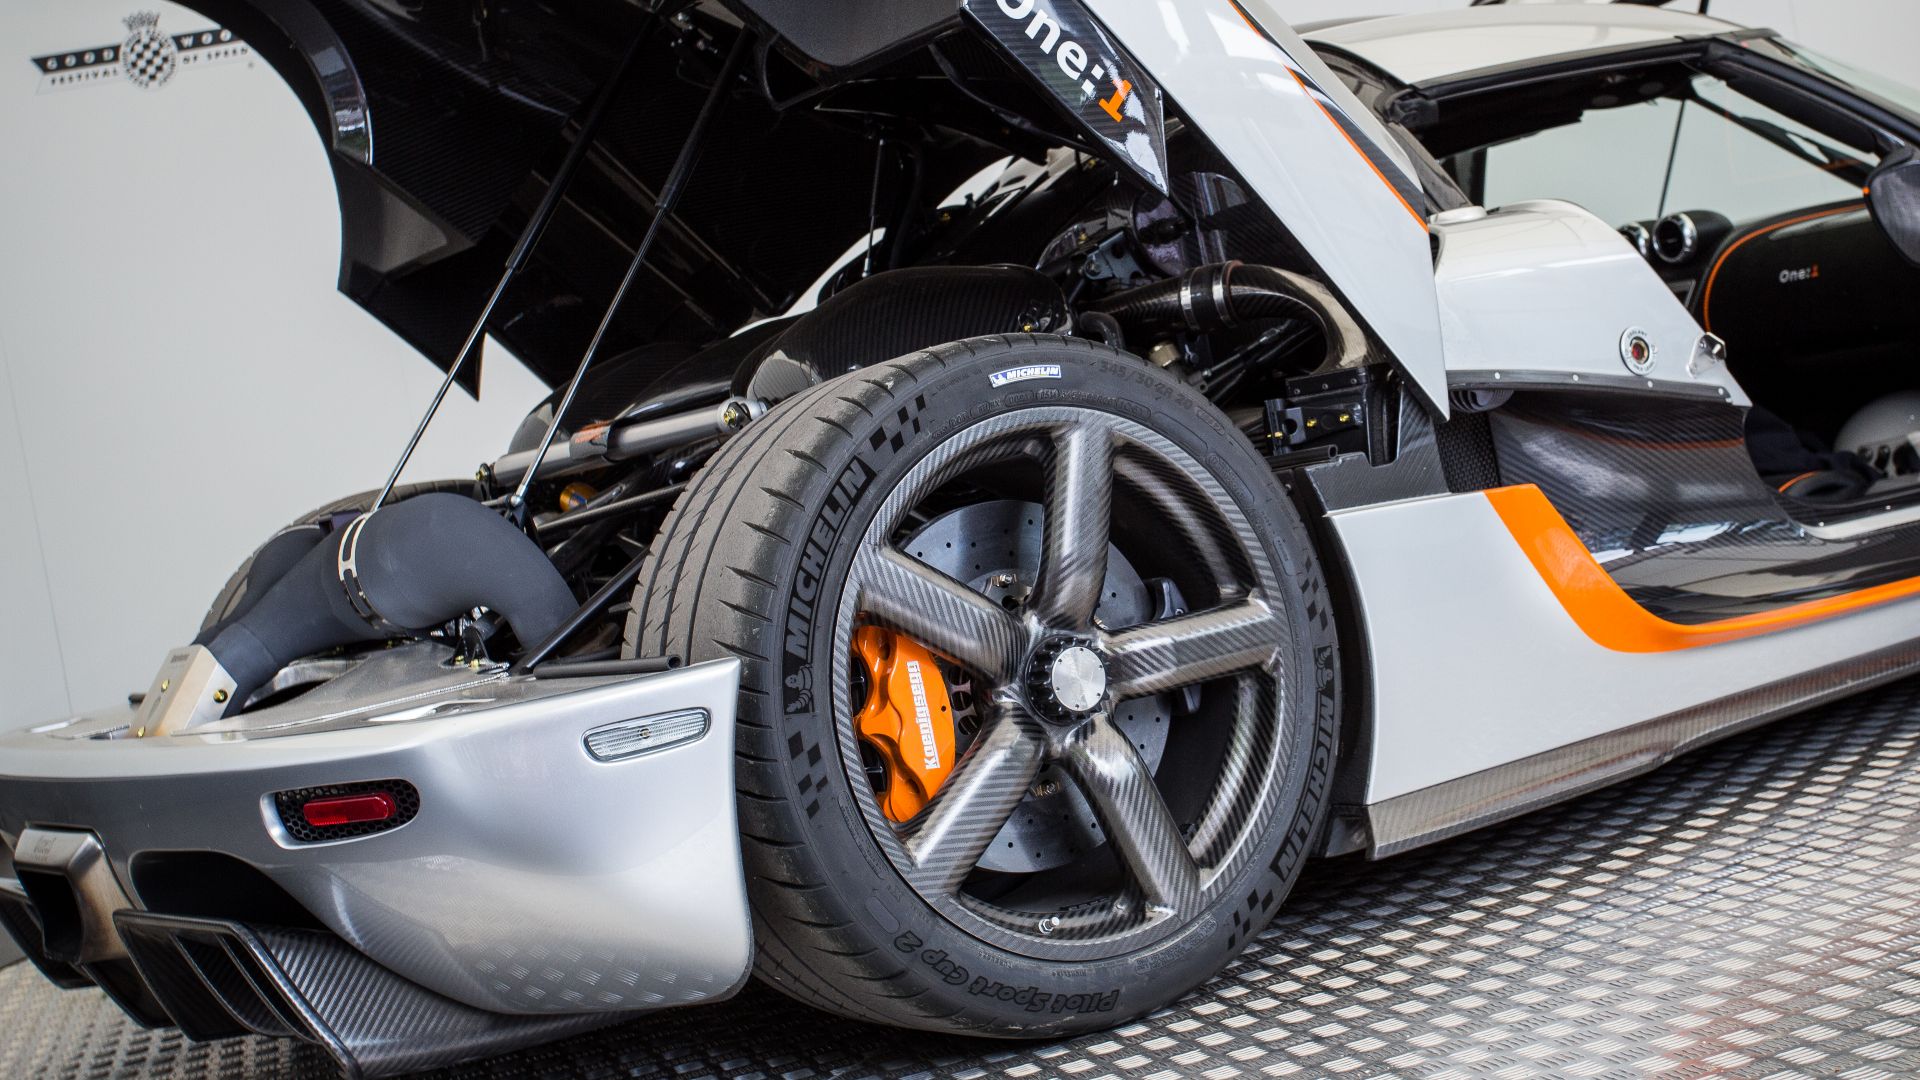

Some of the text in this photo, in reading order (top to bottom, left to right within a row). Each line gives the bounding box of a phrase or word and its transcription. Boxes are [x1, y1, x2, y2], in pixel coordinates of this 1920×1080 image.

[179, 28, 233, 49] WOO
[50, 67, 119, 86] FESTIVAL
[1779, 264, 1819, 283] One:1
[1006, 365, 1060, 380] MICHELIN
[785, 461, 867, 657] MICHELIN
[907, 661, 940, 769] Koenigsegg
[1277, 695, 1335, 883] MICHELIN
[893, 930, 1121, 1014] Pilot Sport Cup 2
